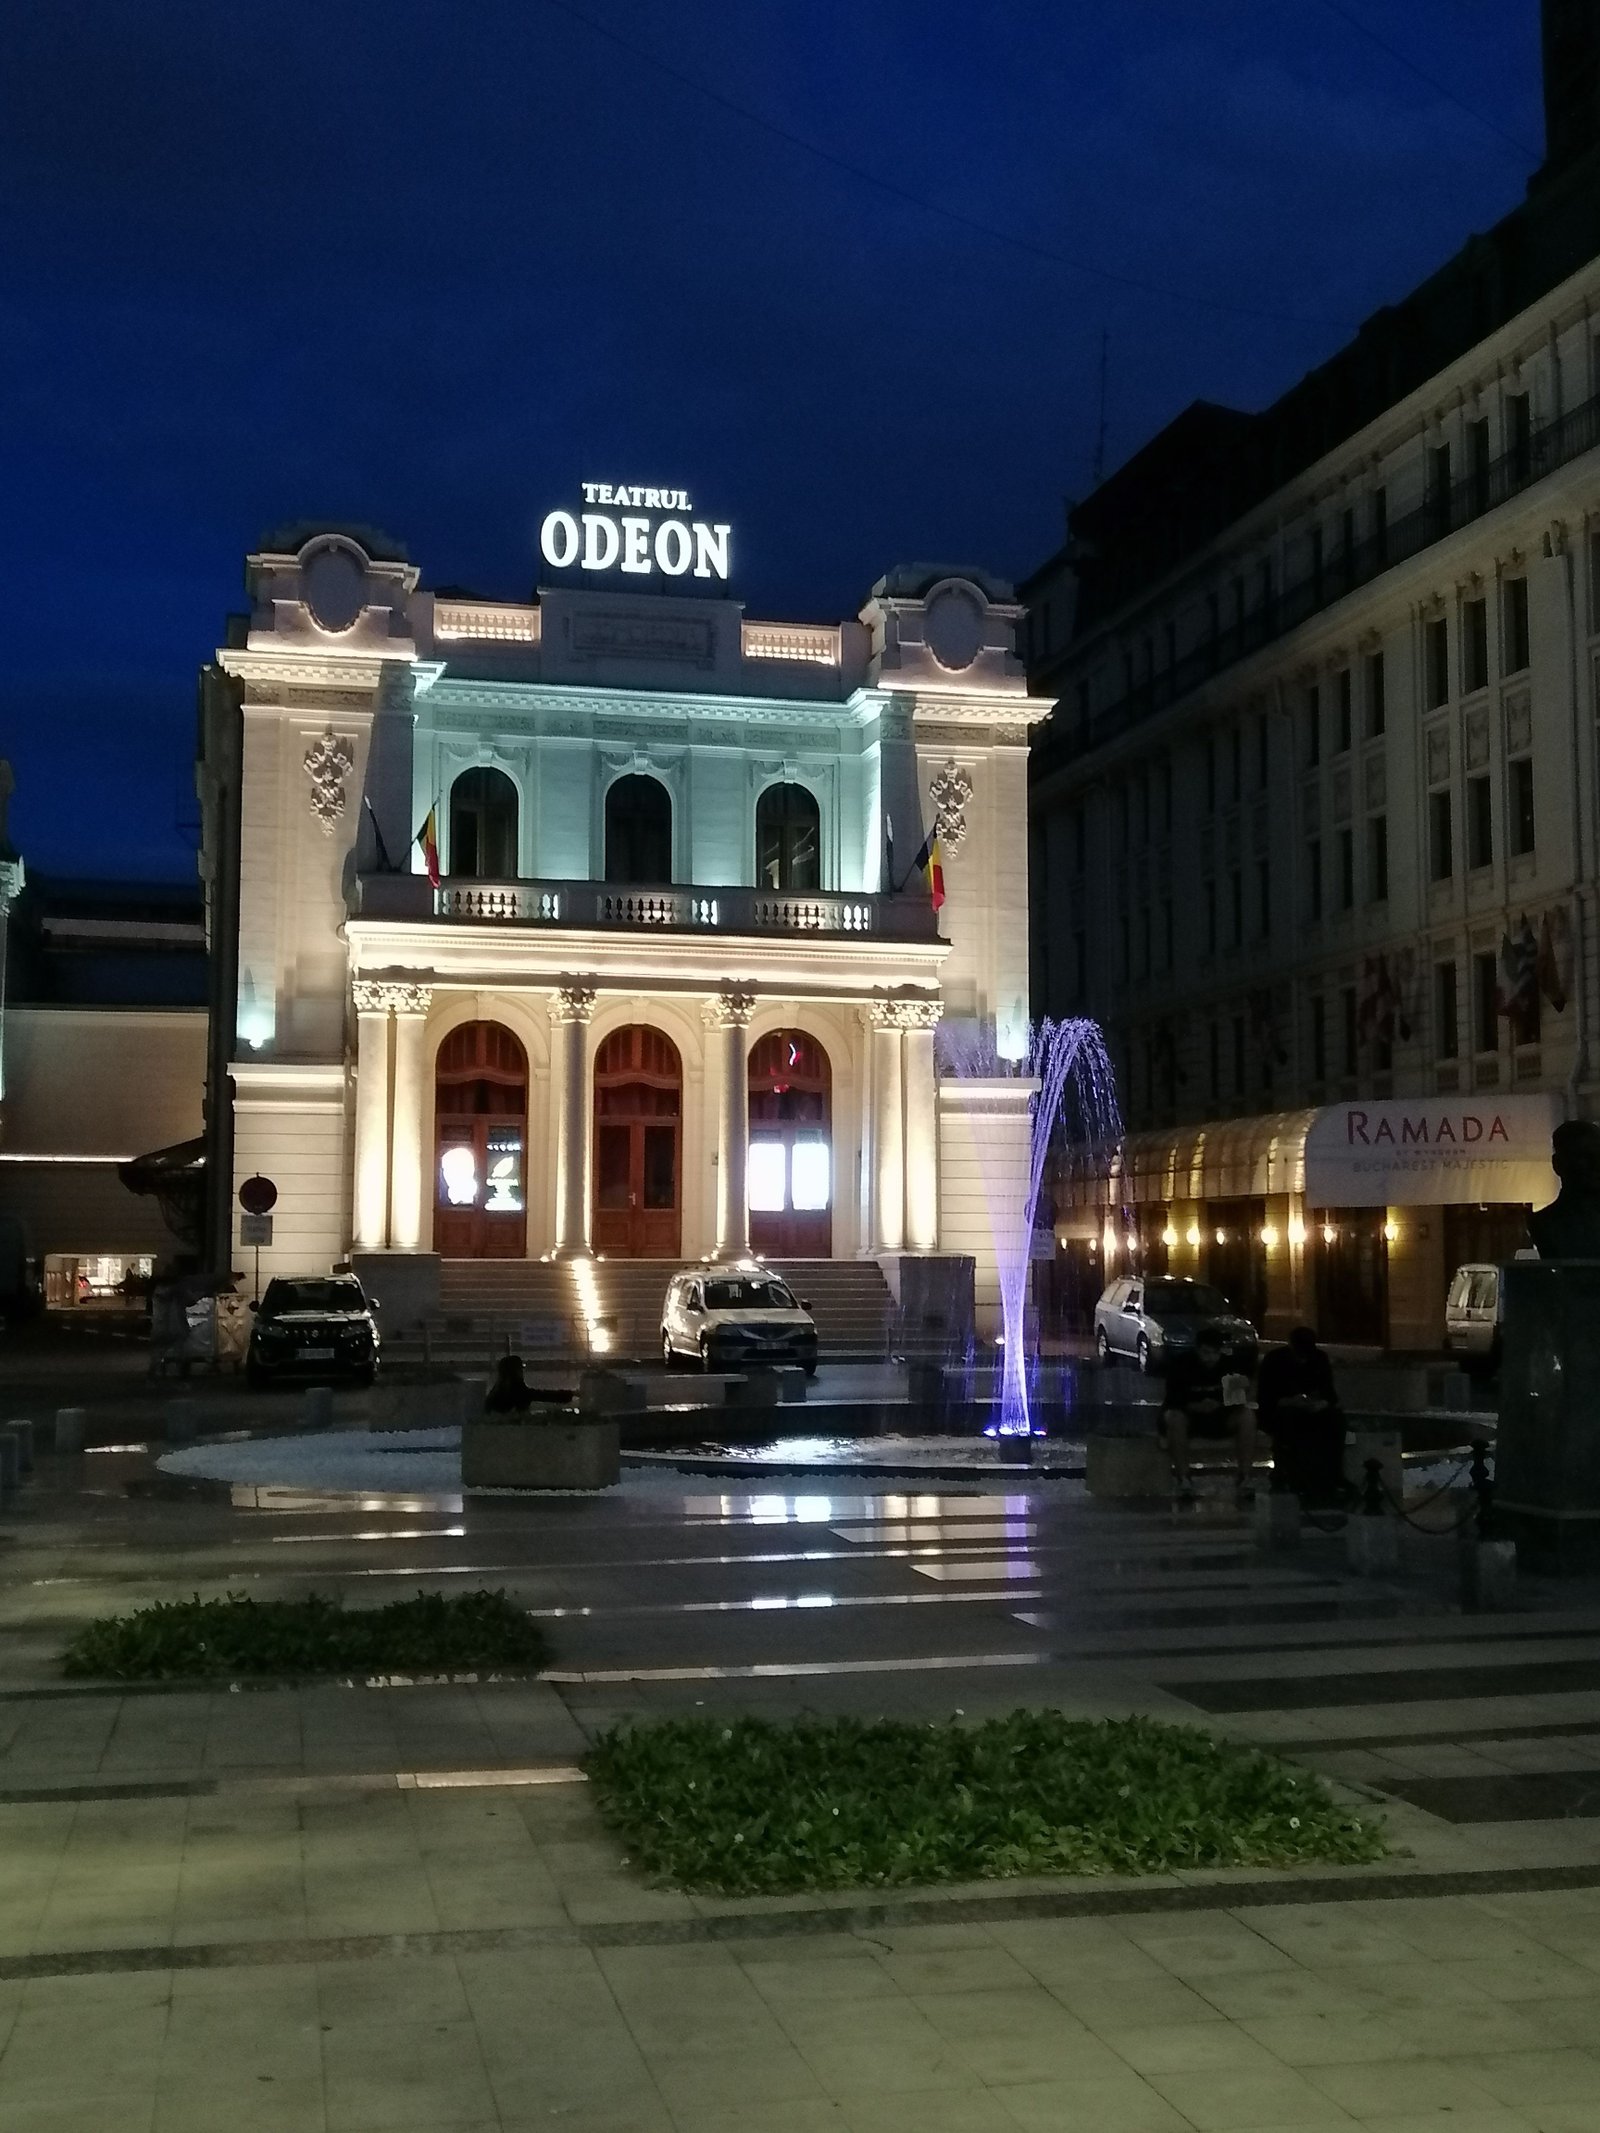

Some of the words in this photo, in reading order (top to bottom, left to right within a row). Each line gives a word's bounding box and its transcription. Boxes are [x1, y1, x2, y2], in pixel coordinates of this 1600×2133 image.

[582, 482, 692, 511] TEATRUL
[540, 511, 731, 579] ODEON
[1348, 1111, 1509, 1144] RAMADA
[1353, 1160, 1436, 1173] BUCHAREST
[1442, 1158, 1509, 1171] MAJESTIC
